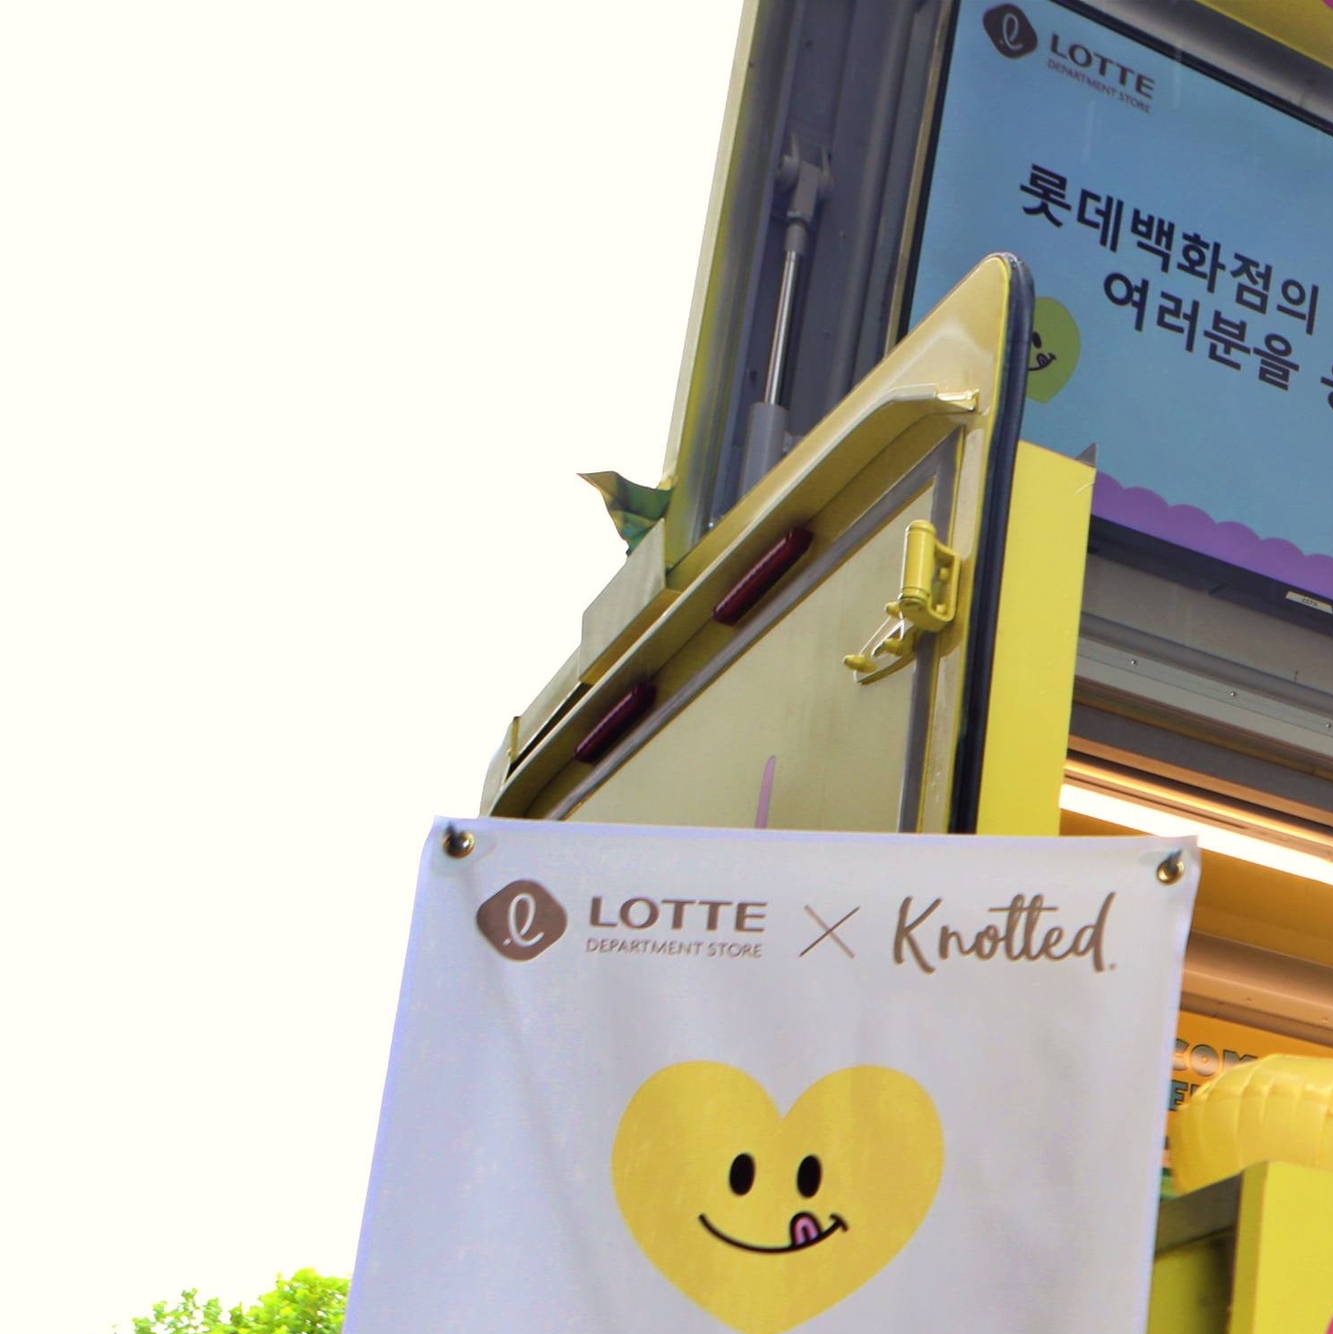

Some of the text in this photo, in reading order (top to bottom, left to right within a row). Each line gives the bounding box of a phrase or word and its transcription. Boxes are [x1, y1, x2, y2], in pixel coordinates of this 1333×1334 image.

[1047, 58, 1151, 114] DEPARTMENT STORE
[1050, 32, 1155, 100] LOTTE
[1019, 163, 1319, 336] 롯데백화점의
[1103, 272, 1300, 392] 여러분을
[588, 896, 768, 933] LOTTE
[586, 937, 764, 959] DEPARTMENT STORE
